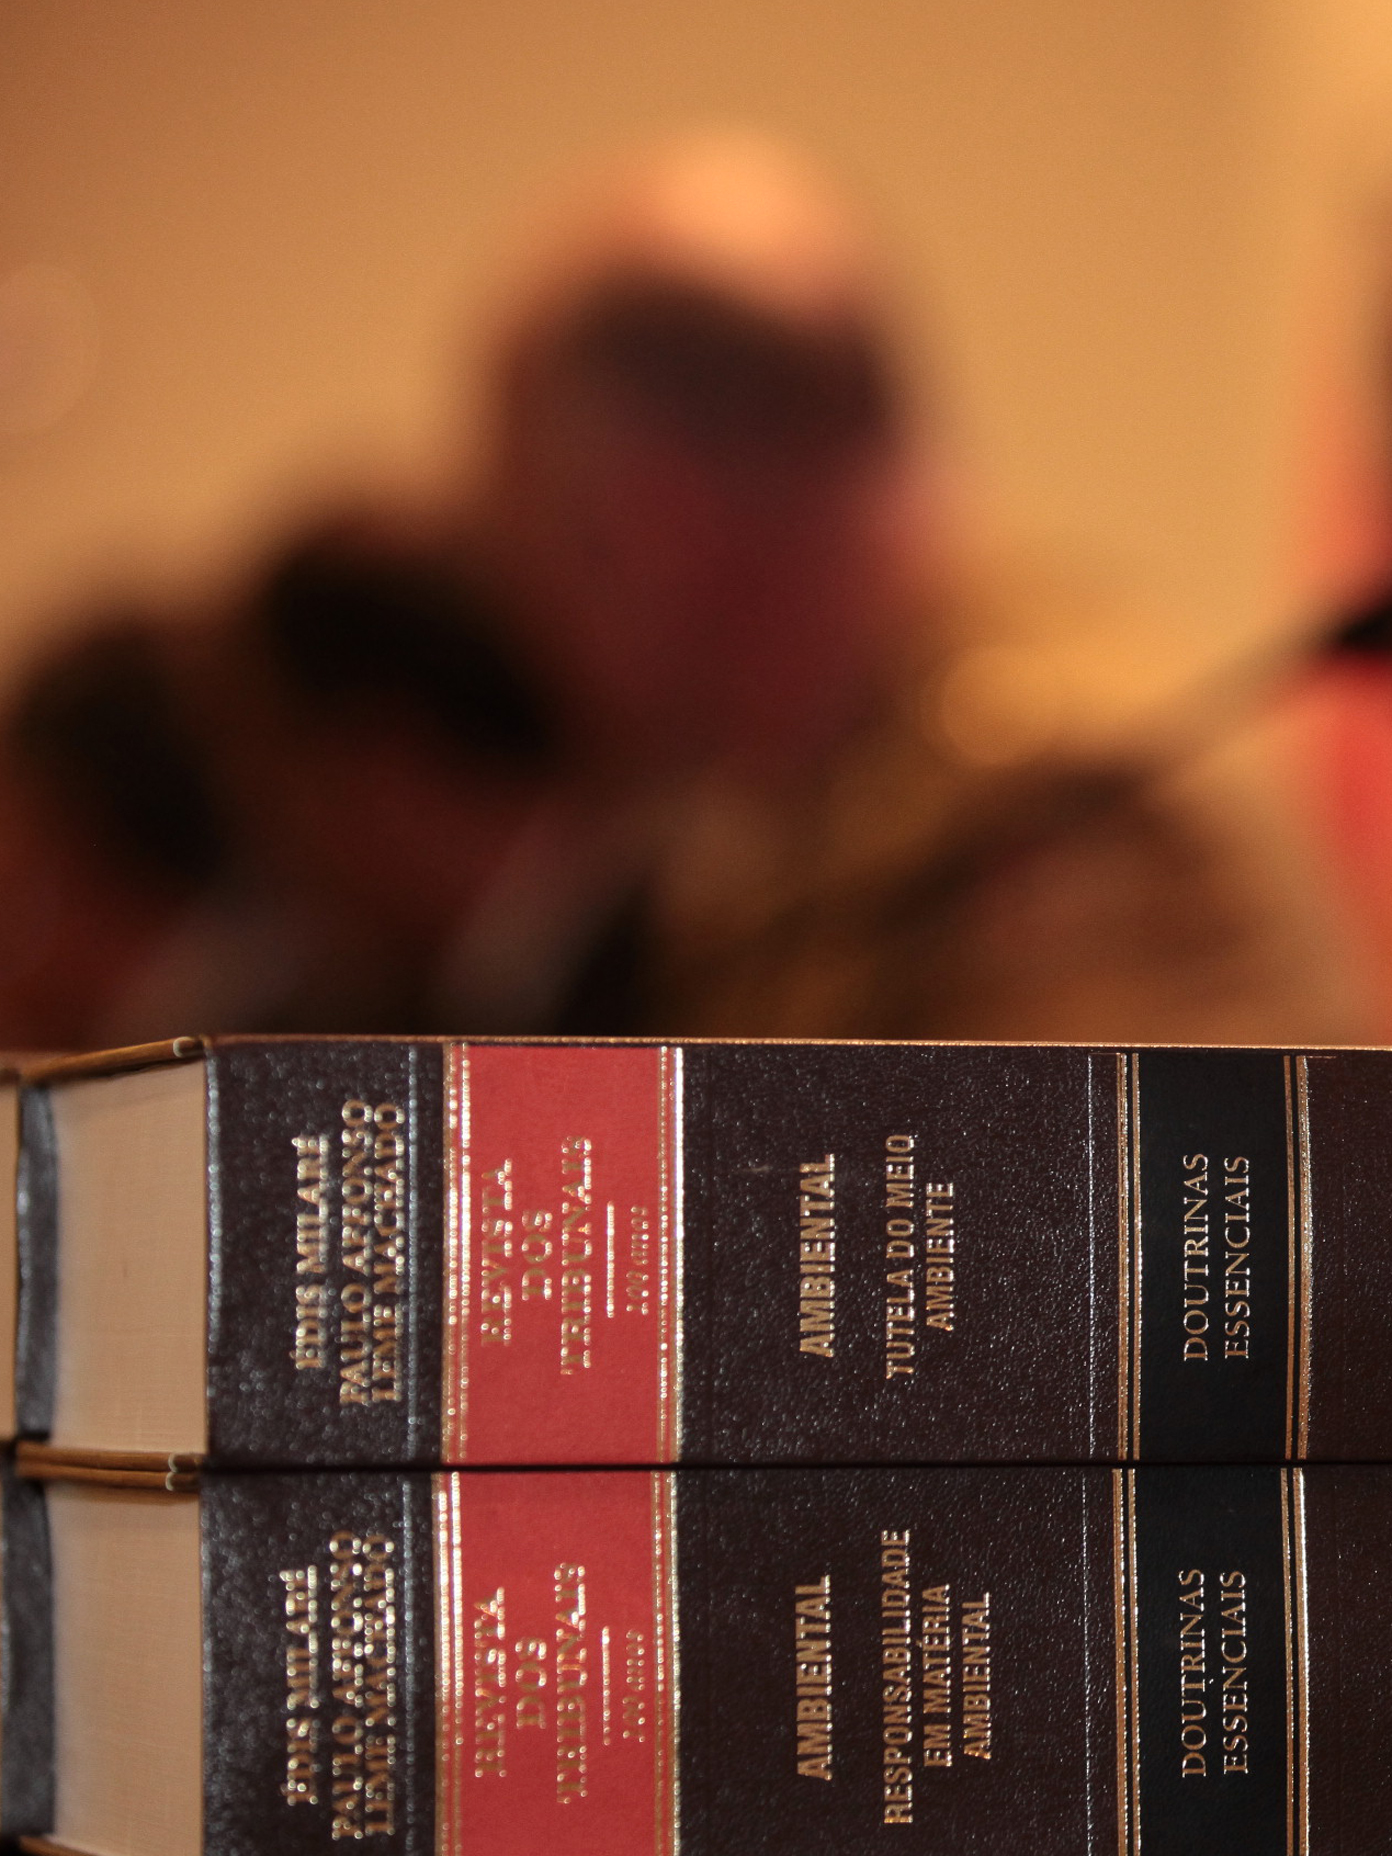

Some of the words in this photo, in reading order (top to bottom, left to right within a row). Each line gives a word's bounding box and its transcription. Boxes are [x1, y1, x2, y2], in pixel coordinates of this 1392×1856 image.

[341, 1099, 373, 1277] AFFONSO
[373, 1102, 405, 1294] MACHADO
[481, 1159, 512, 1346] REVISTA
[522, 1209, 553, 1300] DOS
[560, 1135, 592, 1375] TRIBUNAIS
[800, 1154, 835, 1358] AMBIENTAL
[886, 1134, 915, 1207] MEIO
[886, 1218, 915, 1259] DO
[926, 1182, 954, 1332] AMBIENTE
[1183, 1153, 1208, 1361] DOUTRINAS
[1224, 1156, 1250, 1359] ESSENCIAIS
[340, 1283, 371, 1405] PAULO
[372, 1303, 401, 1402] LEME
[886, 1269, 915, 1380] TUTELA
[362, 1534, 395, 1727] MACHADO
[474, 1587, 507, 1778] REVISTA
[516, 1637, 547, 1729] DOS
[555, 1562, 587, 1803] TRIBUNAIS
[795, 1574, 833, 1780] AMBIENTAL
[881, 1529, 913, 1823] RESPONSABILIDADE
[917, 1583, 951, 1713] MATÉRIA
[962, 1591, 991, 1759] AMBIENTAL
[1179, 1569, 1207, 1777] DOUTRINAS
[1220, 1570, 1248, 1774] ESSENCIAIS
[331, 1716, 363, 1840] PAULO
[364, 1736, 395, 1835] LEME
[924, 1723, 953, 1767] EM
